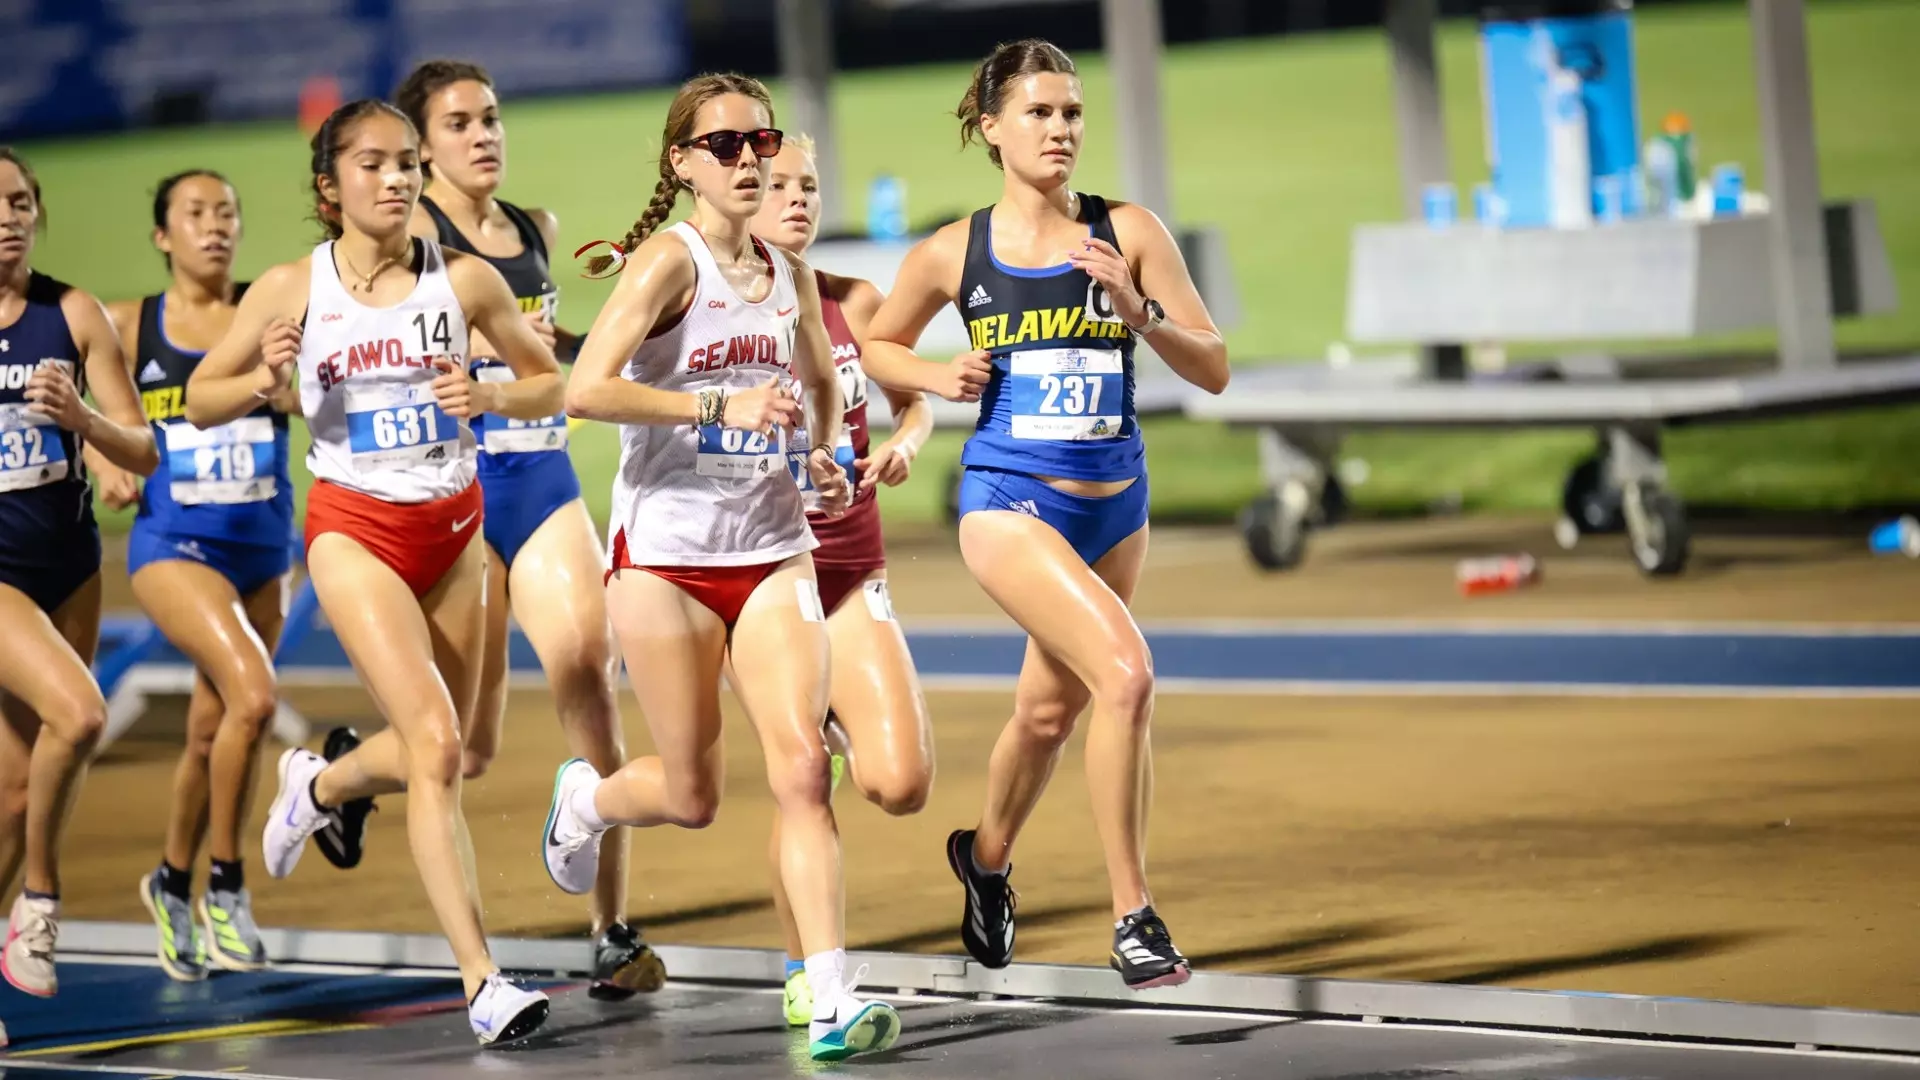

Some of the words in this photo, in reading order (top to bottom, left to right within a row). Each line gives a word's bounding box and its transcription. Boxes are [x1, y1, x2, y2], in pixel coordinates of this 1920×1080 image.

[708, 300, 726, 310] CAA
[968, 296, 992, 309] adidas
[412, 311, 452, 352] 14
[141, 385, 187, 421] DEL
[1039, 375, 1103, 414] 237
[372, 404, 438, 449] 631
[0, 428, 48, 469] 32
